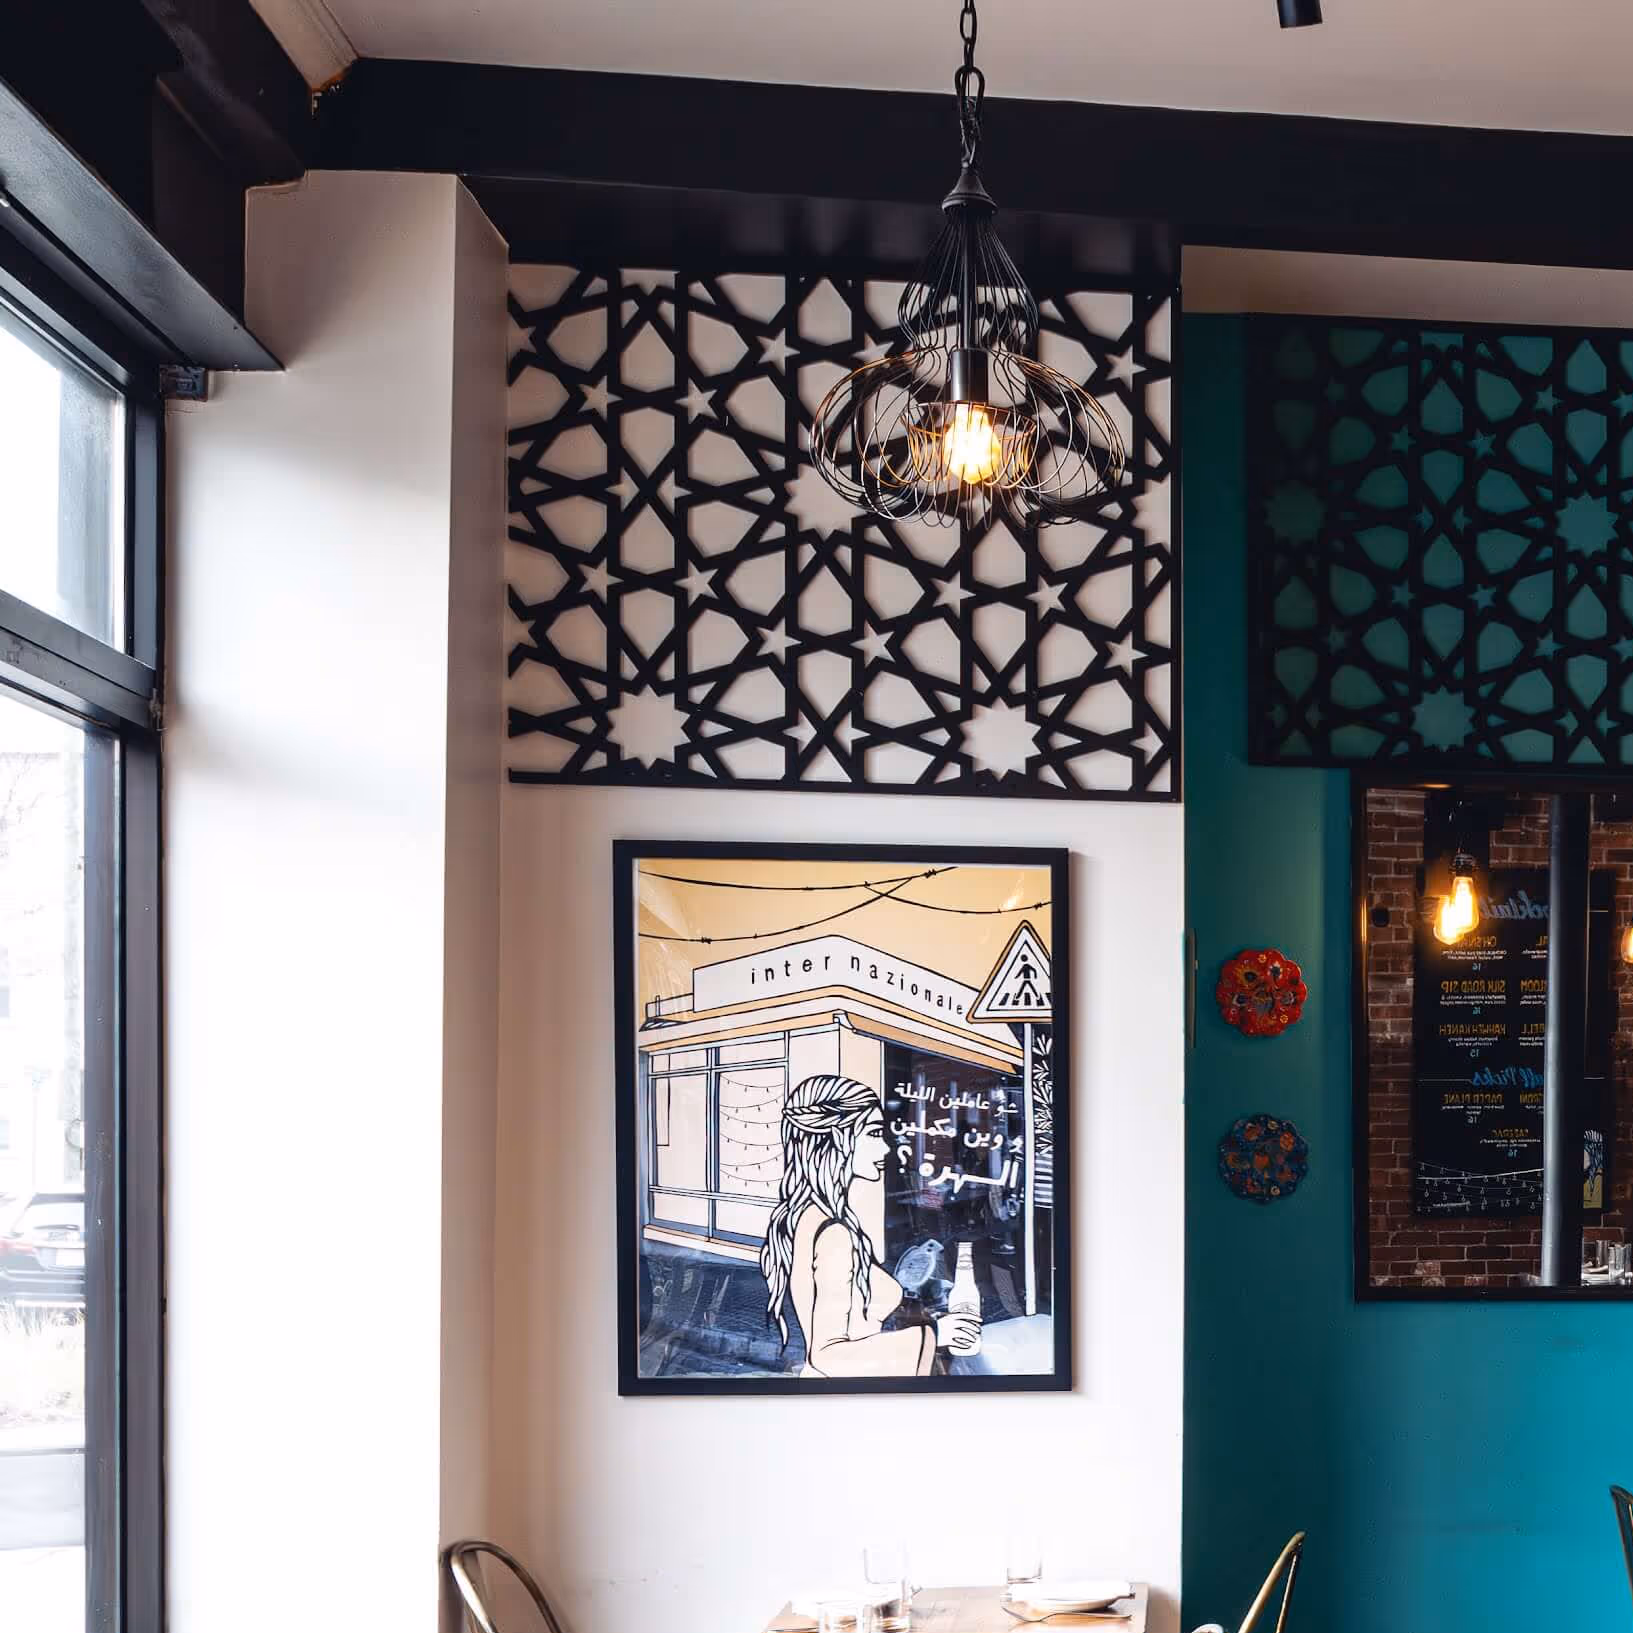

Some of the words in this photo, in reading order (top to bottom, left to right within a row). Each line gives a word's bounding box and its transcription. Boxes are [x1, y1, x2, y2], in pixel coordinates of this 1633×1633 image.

[893, 1082, 936, 1102] الليلة
[938, 1092, 991, 1110] عاملين
[889, 1110, 957, 1138] مكملين
[963, 1127, 1004, 1150] وين
